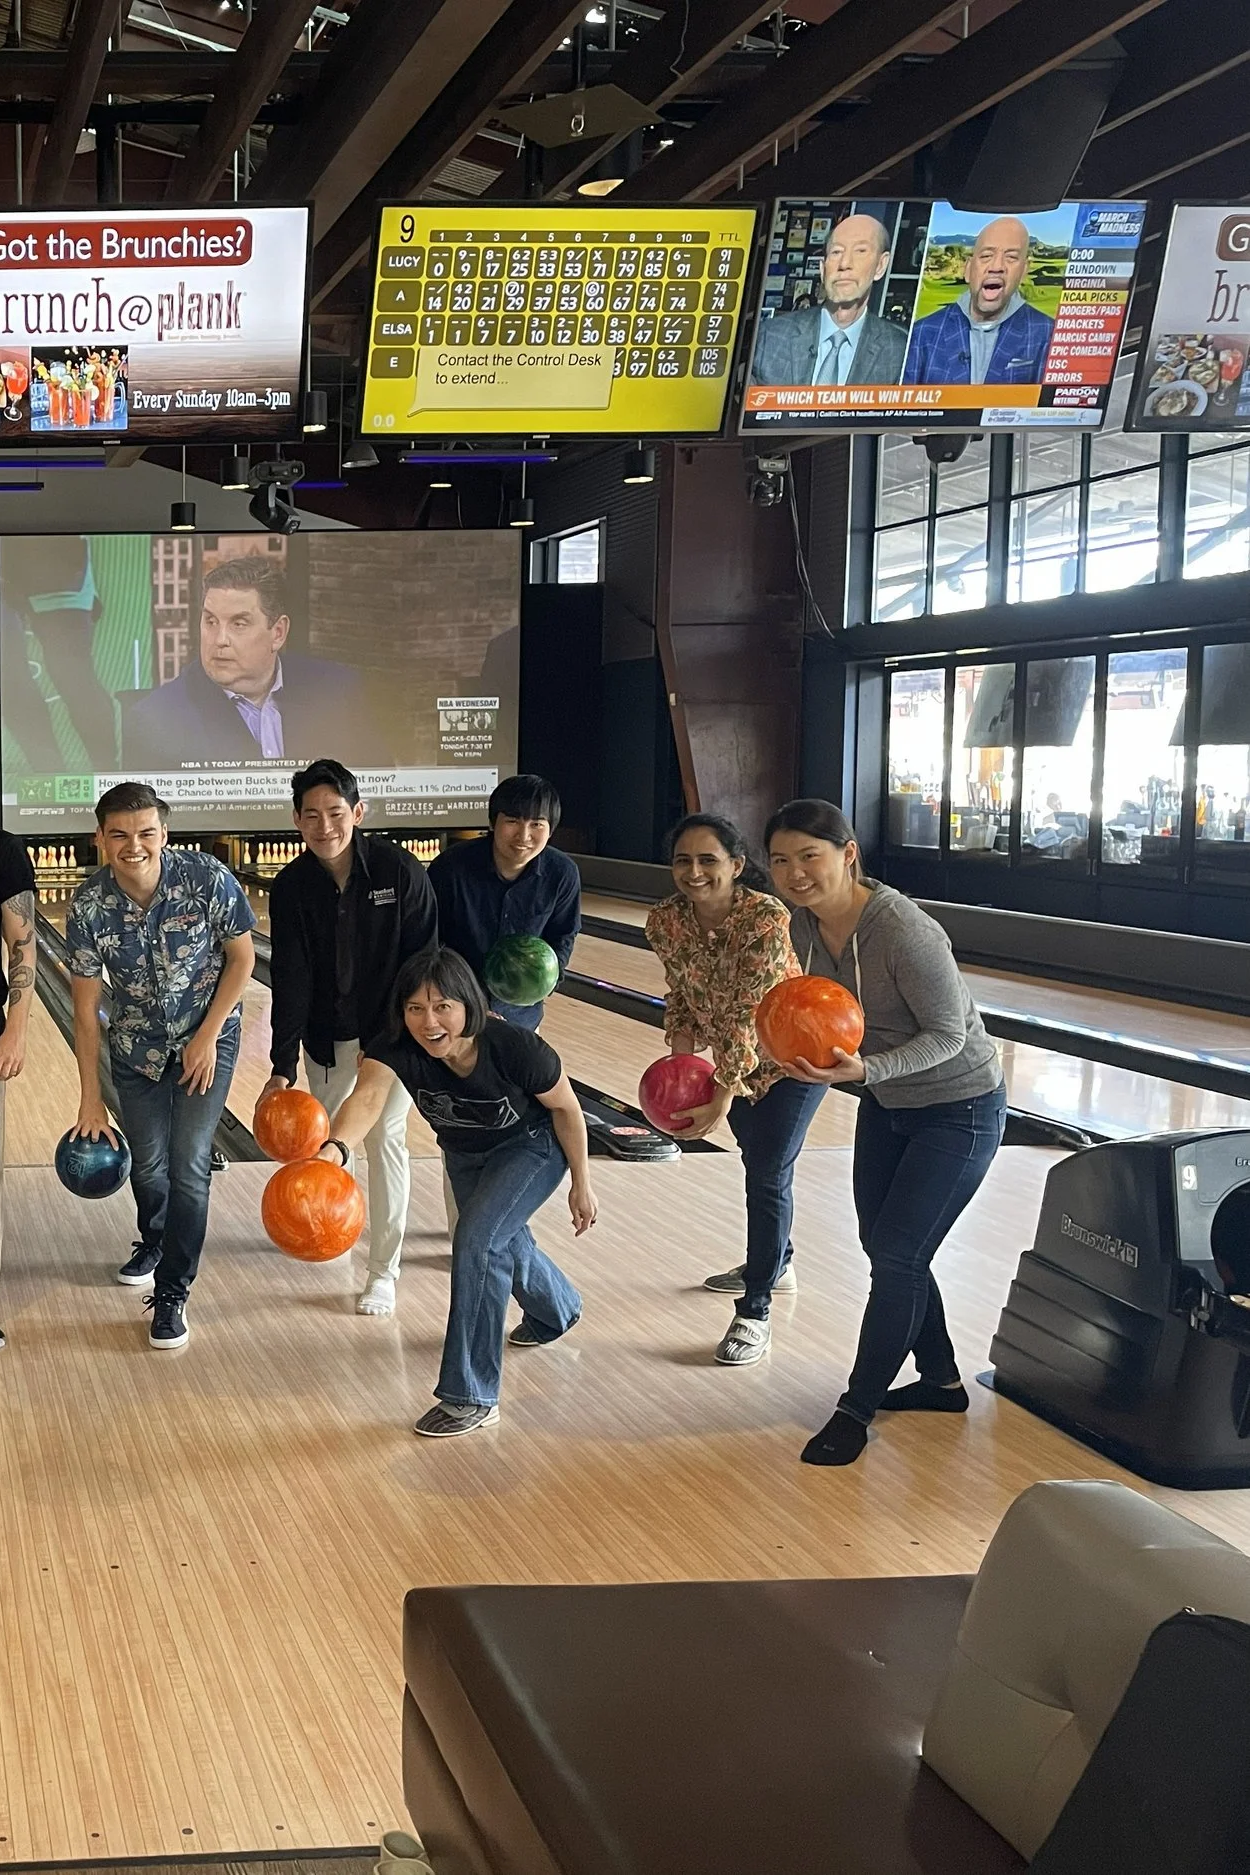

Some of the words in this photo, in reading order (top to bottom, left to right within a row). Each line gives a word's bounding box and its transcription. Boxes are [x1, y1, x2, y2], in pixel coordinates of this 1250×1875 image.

[1099, 213, 1128, 223] MARCH
[400, 215, 415, 242] 9
[1099, 223, 1140, 234] MADNESS
[46, 229, 92, 260] the
[103, 226, 246, 260] Brunchies?
[440, 233, 444, 242] 1
[466, 233, 472, 242] 2
[494, 233, 500, 242] 3
[520, 233, 527, 242] 4
[548, 233, 554, 242] 5
[575, 233, 581, 242] 6
[603, 233, 609, 242] 7
[629, 233, 636, 242] 8
[656, 233, 662, 242] 9
[682, 233, 692, 242] 10
[719, 233, 741, 241] TTL
[720, 250, 731, 261] 91
[1071, 250, 1094, 260] 0:00
[388, 256, 420, 268] LUCY
[434, 263, 444, 277] 0
[461, 263, 470, 277] 9
[486, 263, 499, 277] 17
[511, 263, 528, 277] 25
[538, 263, 555, 277] 33
[564, 263, 582, 277] 53
[594, 263, 606, 277] 71
[618, 263, 635, 277] 79
[644, 263, 661, 277] 85
[677, 263, 690, 277] 91
[718, 264, 729, 277] 91
[1069, 264, 1116, 275] RUNDOWN
[714, 283, 727, 294] 74
[1065, 278, 1106, 288] VIRGINIA
[396, 291, 405, 301] A
[712, 297, 724, 310] 74
[1063, 292, 1087, 301] NCAA
[1091, 292, 1118, 301] PICKS
[1060, 306, 1121, 316] DODGERS/PADS
[1057, 320, 1104, 329] BRACKETS
[382, 324, 412, 334] ELSA
[531, 330, 545, 343] 10
[558, 330, 571, 343] 12
[582, 330, 599, 343] 30
[608, 330, 626, 343] 38
[634, 330, 652, 343] 47
[664, 330, 682, 343] 57
[706, 330, 720, 343] 57
[1053, 334, 1086, 342] MARCUS
[1089, 334, 1116, 342] CAMBY
[1051, 346, 1068, 356] EPIC
[1070, 346, 1113, 356] COMEBACK
[438, 354, 488, 366] Contact
[492, 354, 512, 366] the
[517, 354, 564, 366] Control
[568, 354, 601, 366] Desk
[1049, 360, 1068, 369] USC
[390, 357, 398, 367] E
[630, 363, 647, 376] 97
[658, 363, 679, 376] 105
[699, 362, 716, 375] 105
[436, 373, 447, 384] to
[1045, 373, 1082, 382] ERRORS
[777, 393, 813, 405] WHICH
[817, 392, 846, 404] TEAM
[850, 391, 875, 404] WILL
[879, 391, 900, 403] WIN
[902, 391, 913, 403] IT
[915, 390, 942, 403] ALL?
[1055, 388, 1099, 396] PARDON
[132, 391, 171, 412] Every
[176, 390, 221, 410] Sunday
[156, 778, 172, 786] the
[176, 779, 196, 787] gap
[198, 777, 242, 785] between
[246, 776, 277, 784] Bucks
[386, 785, 416, 793] Bucks:
[442, 784, 462, 793] (2nd
[385, 802, 434, 811] GRIZZLIES
[1183, 1166, 1196, 1188] 9
